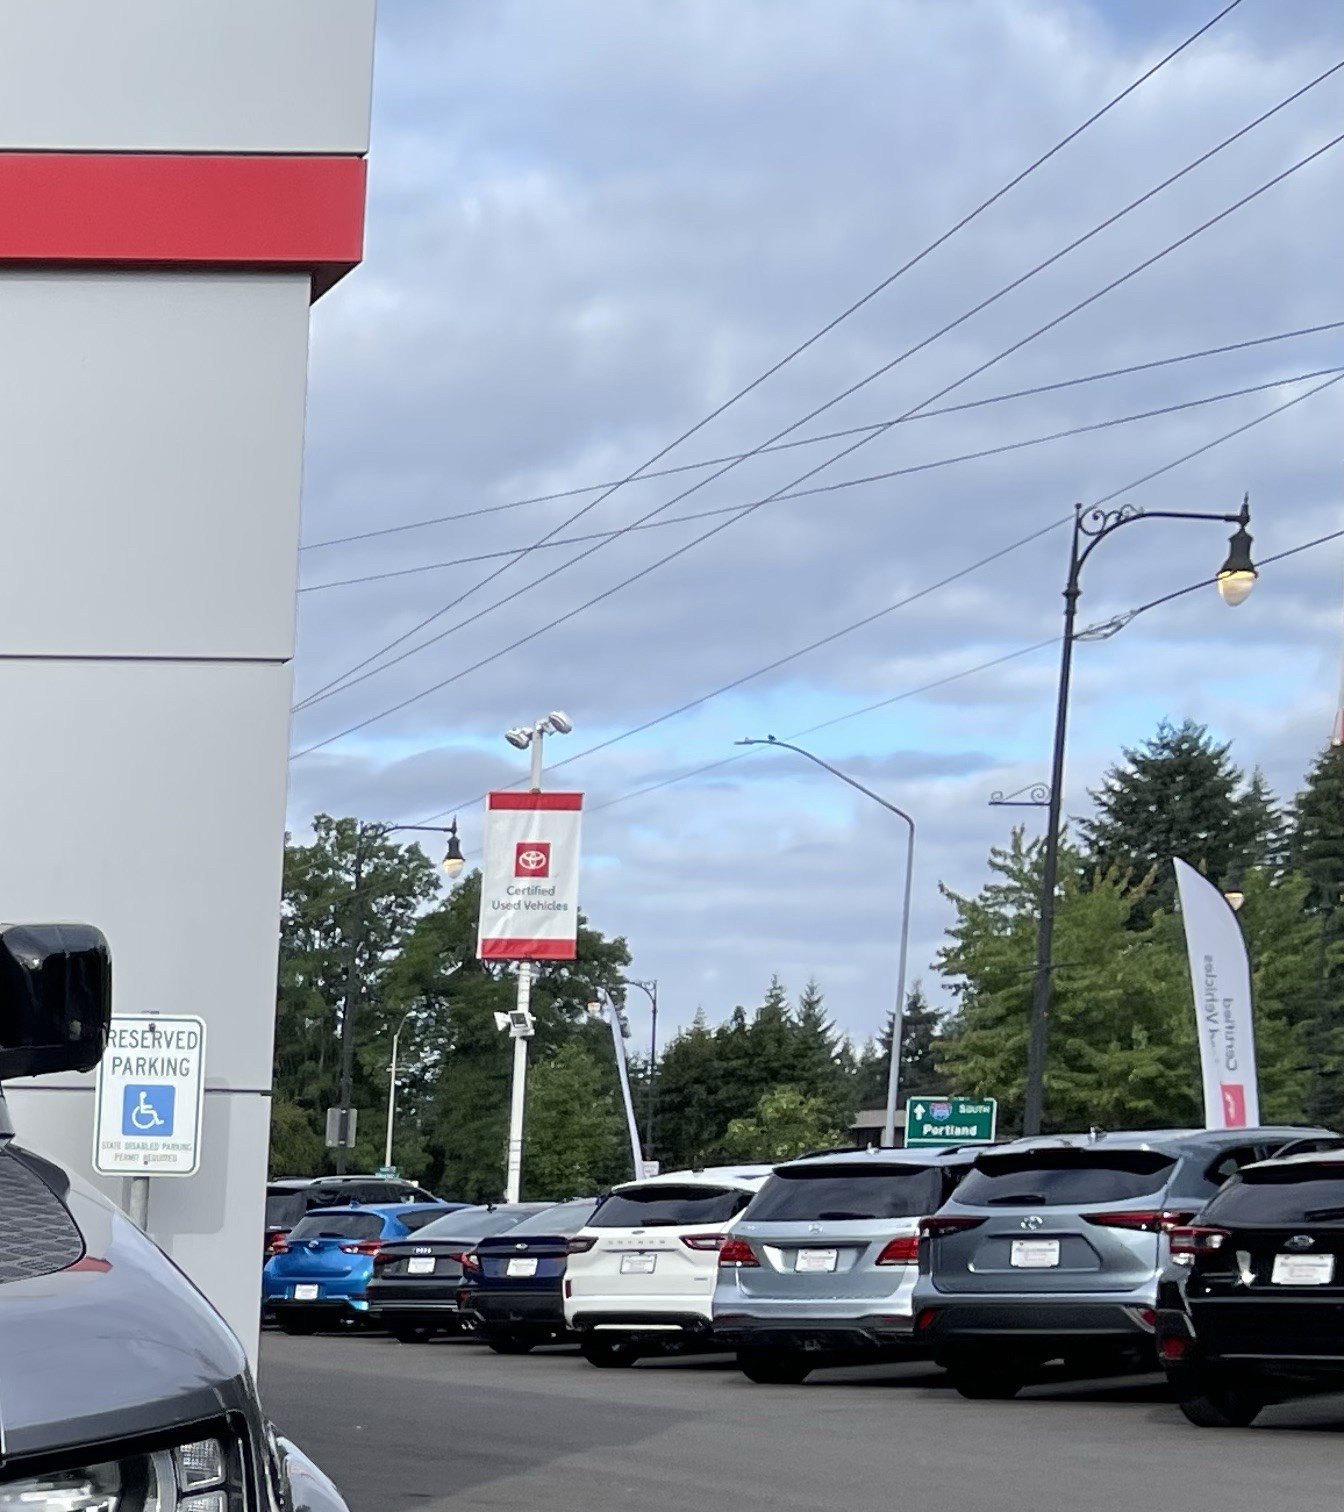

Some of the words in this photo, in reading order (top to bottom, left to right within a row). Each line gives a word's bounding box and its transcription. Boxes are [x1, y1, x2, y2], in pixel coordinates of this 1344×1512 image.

[506, 885, 556, 896] Certified
[492, 900, 520, 911] Used
[524, 900, 569, 912] Vehicles
[108, 1029, 199, 1050] RESERVED
[111, 1056, 191, 1077] PARKING
[922, 1123, 978, 1137] Portland
[161, 1142, 193, 1152] PARKING
